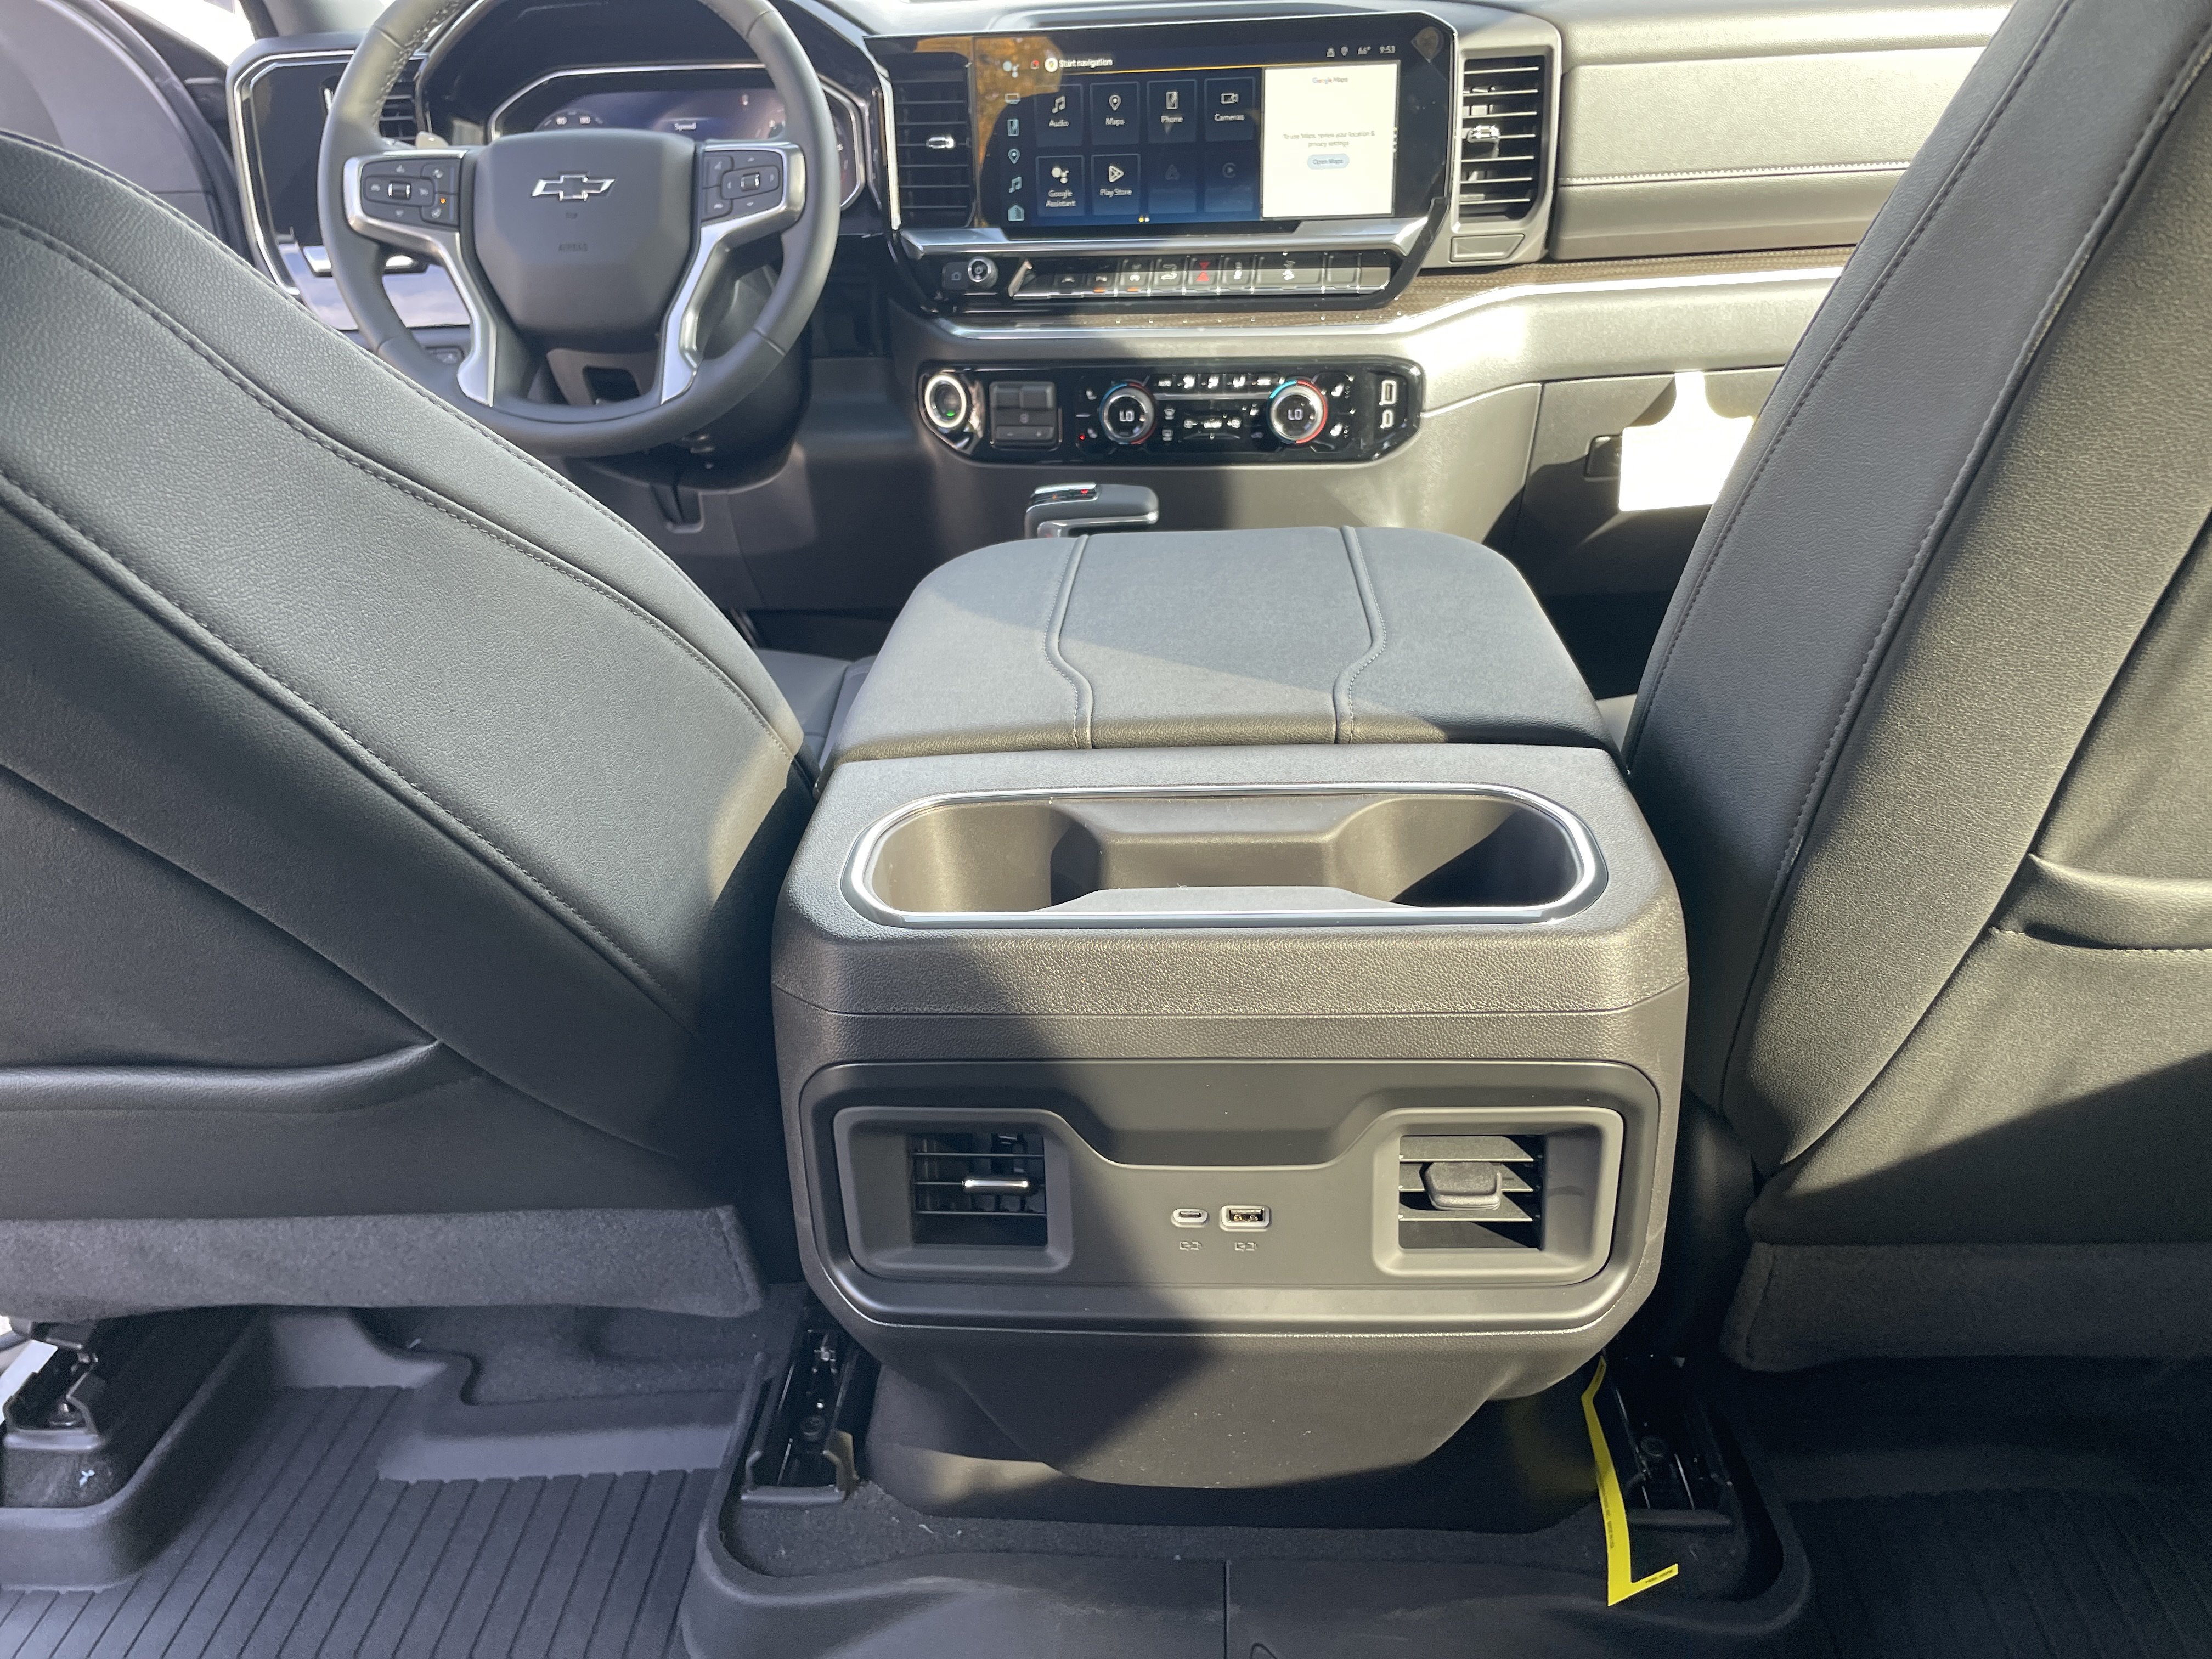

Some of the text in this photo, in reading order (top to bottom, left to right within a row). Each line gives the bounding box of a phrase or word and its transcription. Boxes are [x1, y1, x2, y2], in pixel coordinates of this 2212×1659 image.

[1076, 58, 1113, 69] navigation
[675, 122, 696, 132] Speed
[1105, 118, 1125, 126] Maps
[1048, 189, 1073, 199] Google
[1100, 188, 1114, 198] Play
[1288, 409, 1303, 420] LO
